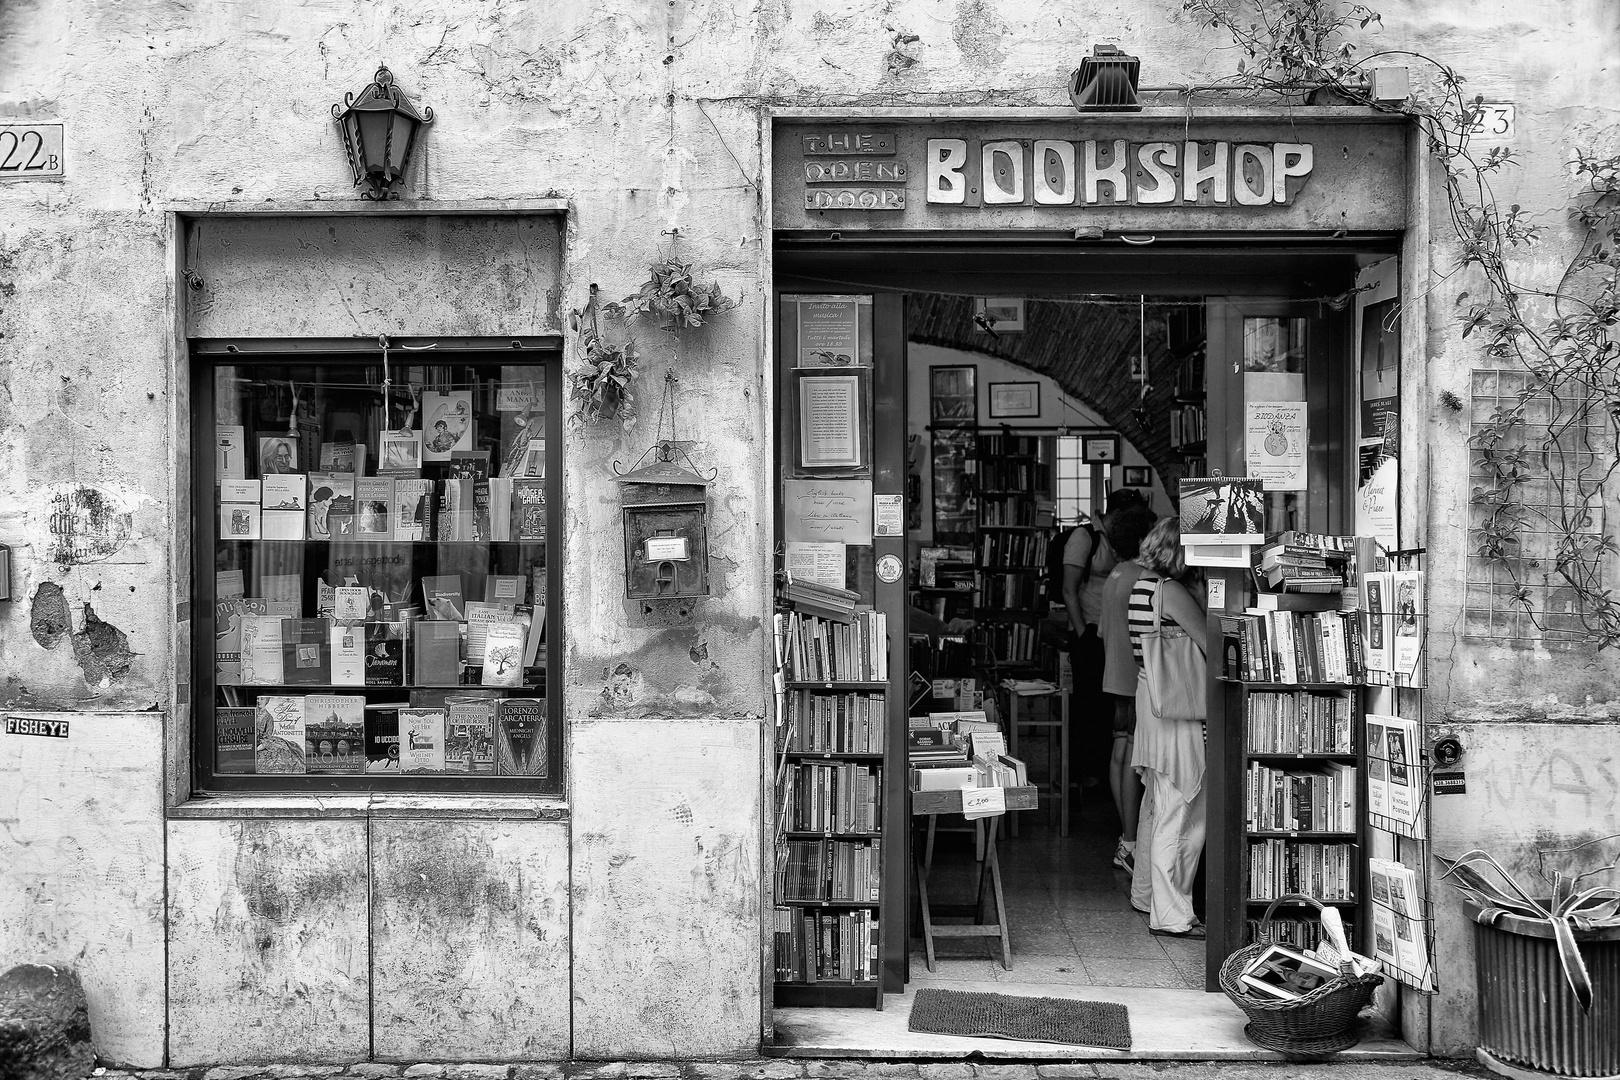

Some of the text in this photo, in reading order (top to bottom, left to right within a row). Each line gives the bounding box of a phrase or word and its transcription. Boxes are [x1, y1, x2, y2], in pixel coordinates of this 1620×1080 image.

[804, 133, 875, 153] THE
[805, 161, 900, 180] OPEN
[927, 138, 1314, 206] BOOKSHOP
[813, 189, 900, 208] DOOR
[517, 488, 543, 499] HUNGER
[522, 496, 546, 504] GAMES
[954, 581, 975, 589] SPAIN
[504, 707, 539, 715] LORENZO
[499, 714, 544, 722] CARCATERRA
[6, 719, 69, 737] FISHEYE
[310, 751, 359, 764] ROME
[1392, 805, 1410, 816] POSTERS
